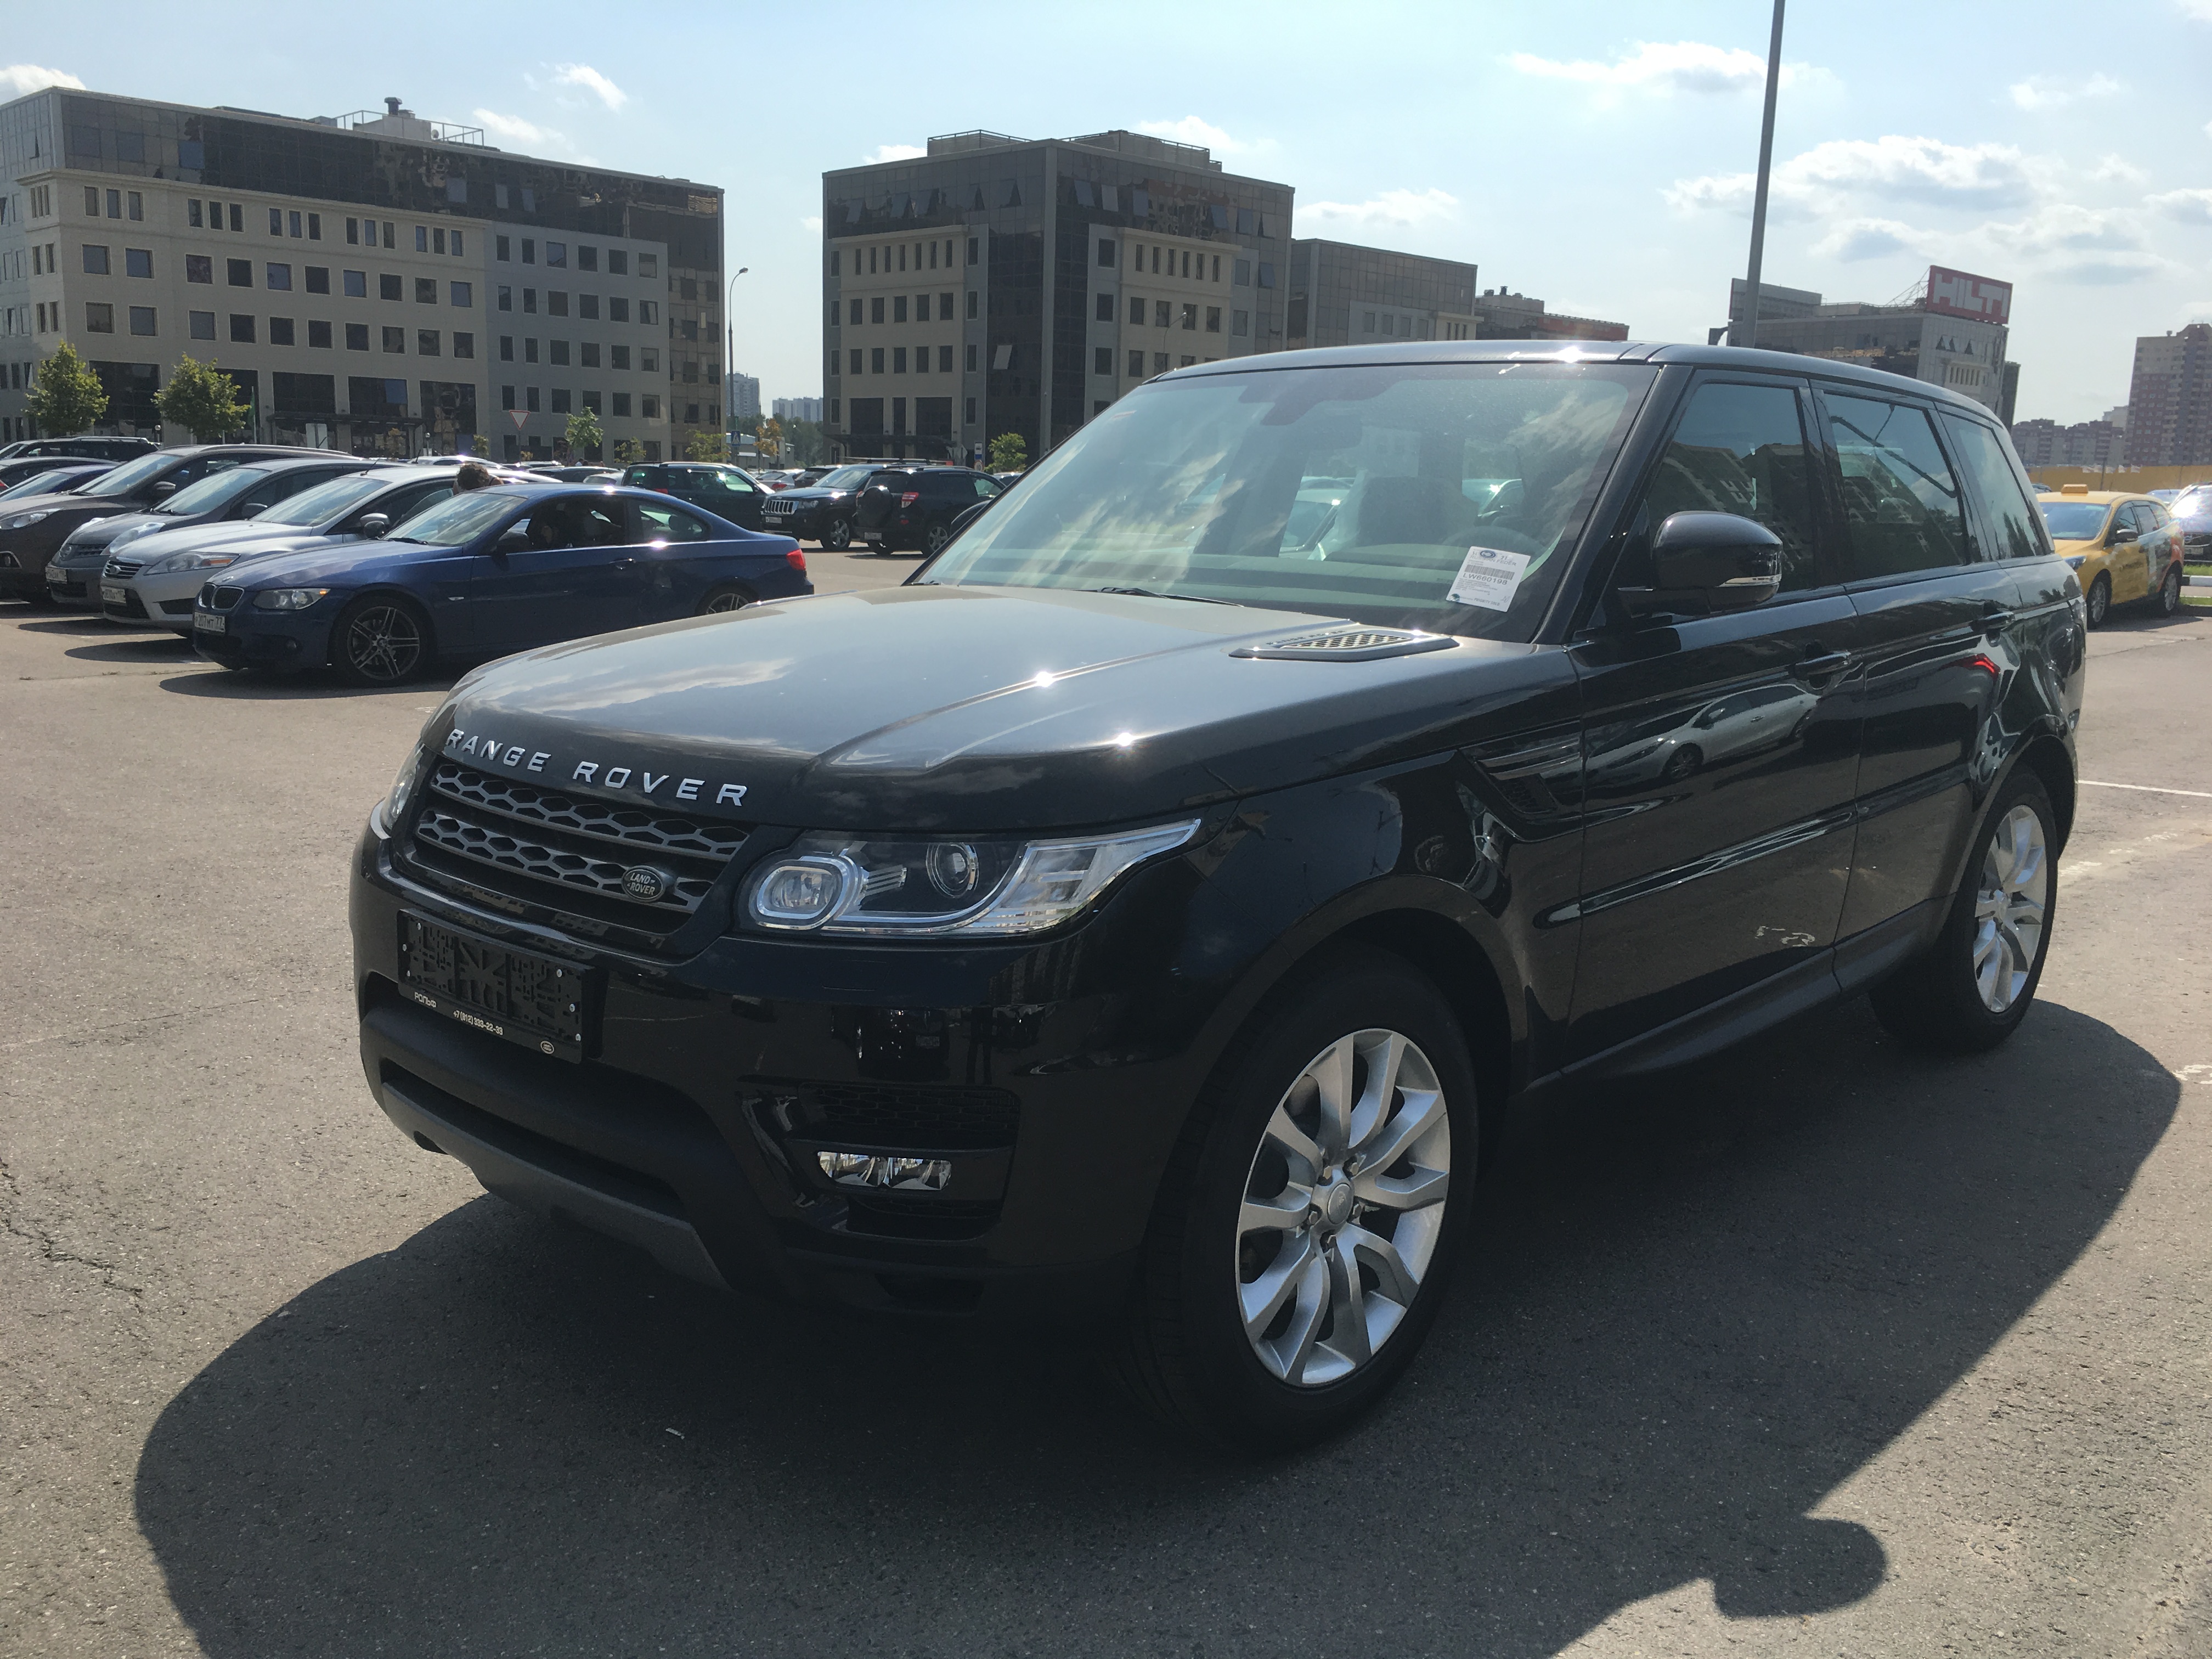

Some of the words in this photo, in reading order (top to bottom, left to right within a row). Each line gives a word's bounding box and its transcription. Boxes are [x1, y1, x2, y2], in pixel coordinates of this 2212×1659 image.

[1933, 273, 2011, 318] HILTI
[1463, 573, 1508, 585] LW660198
[445, 728, 551, 772] RANGE
[572, 760, 747, 806] ROVER
[630, 882, 656, 895] ROVER
